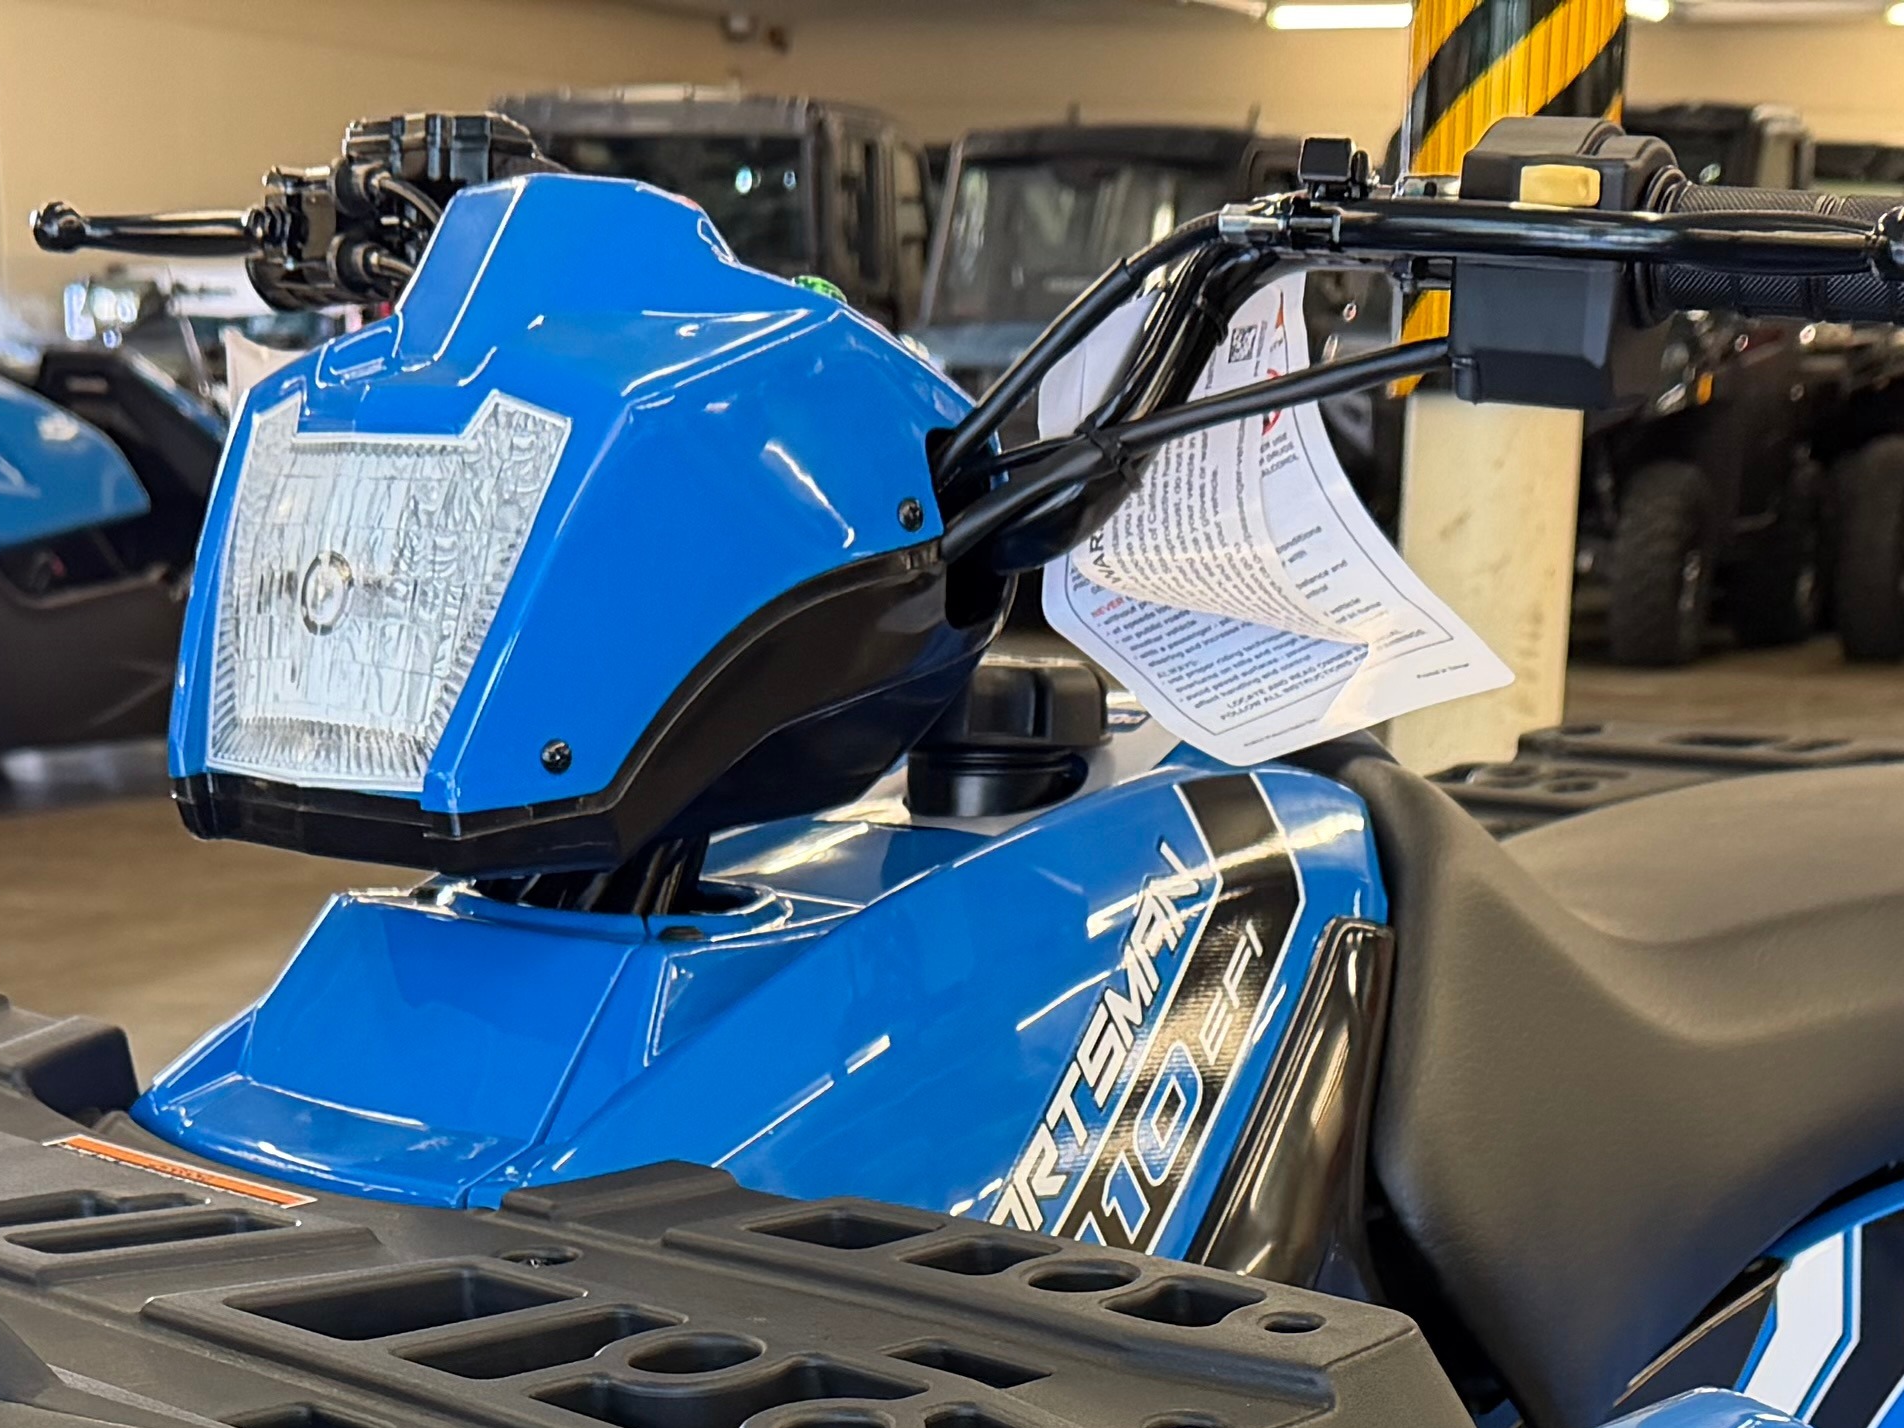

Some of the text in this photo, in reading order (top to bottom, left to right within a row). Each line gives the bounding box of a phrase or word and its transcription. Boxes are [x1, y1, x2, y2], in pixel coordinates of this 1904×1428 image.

[1090, 596, 1125, 618] NEVER
[989, 842, 1202, 1234] RTSMAN
[1199, 921, 1265, 1067] EFI
